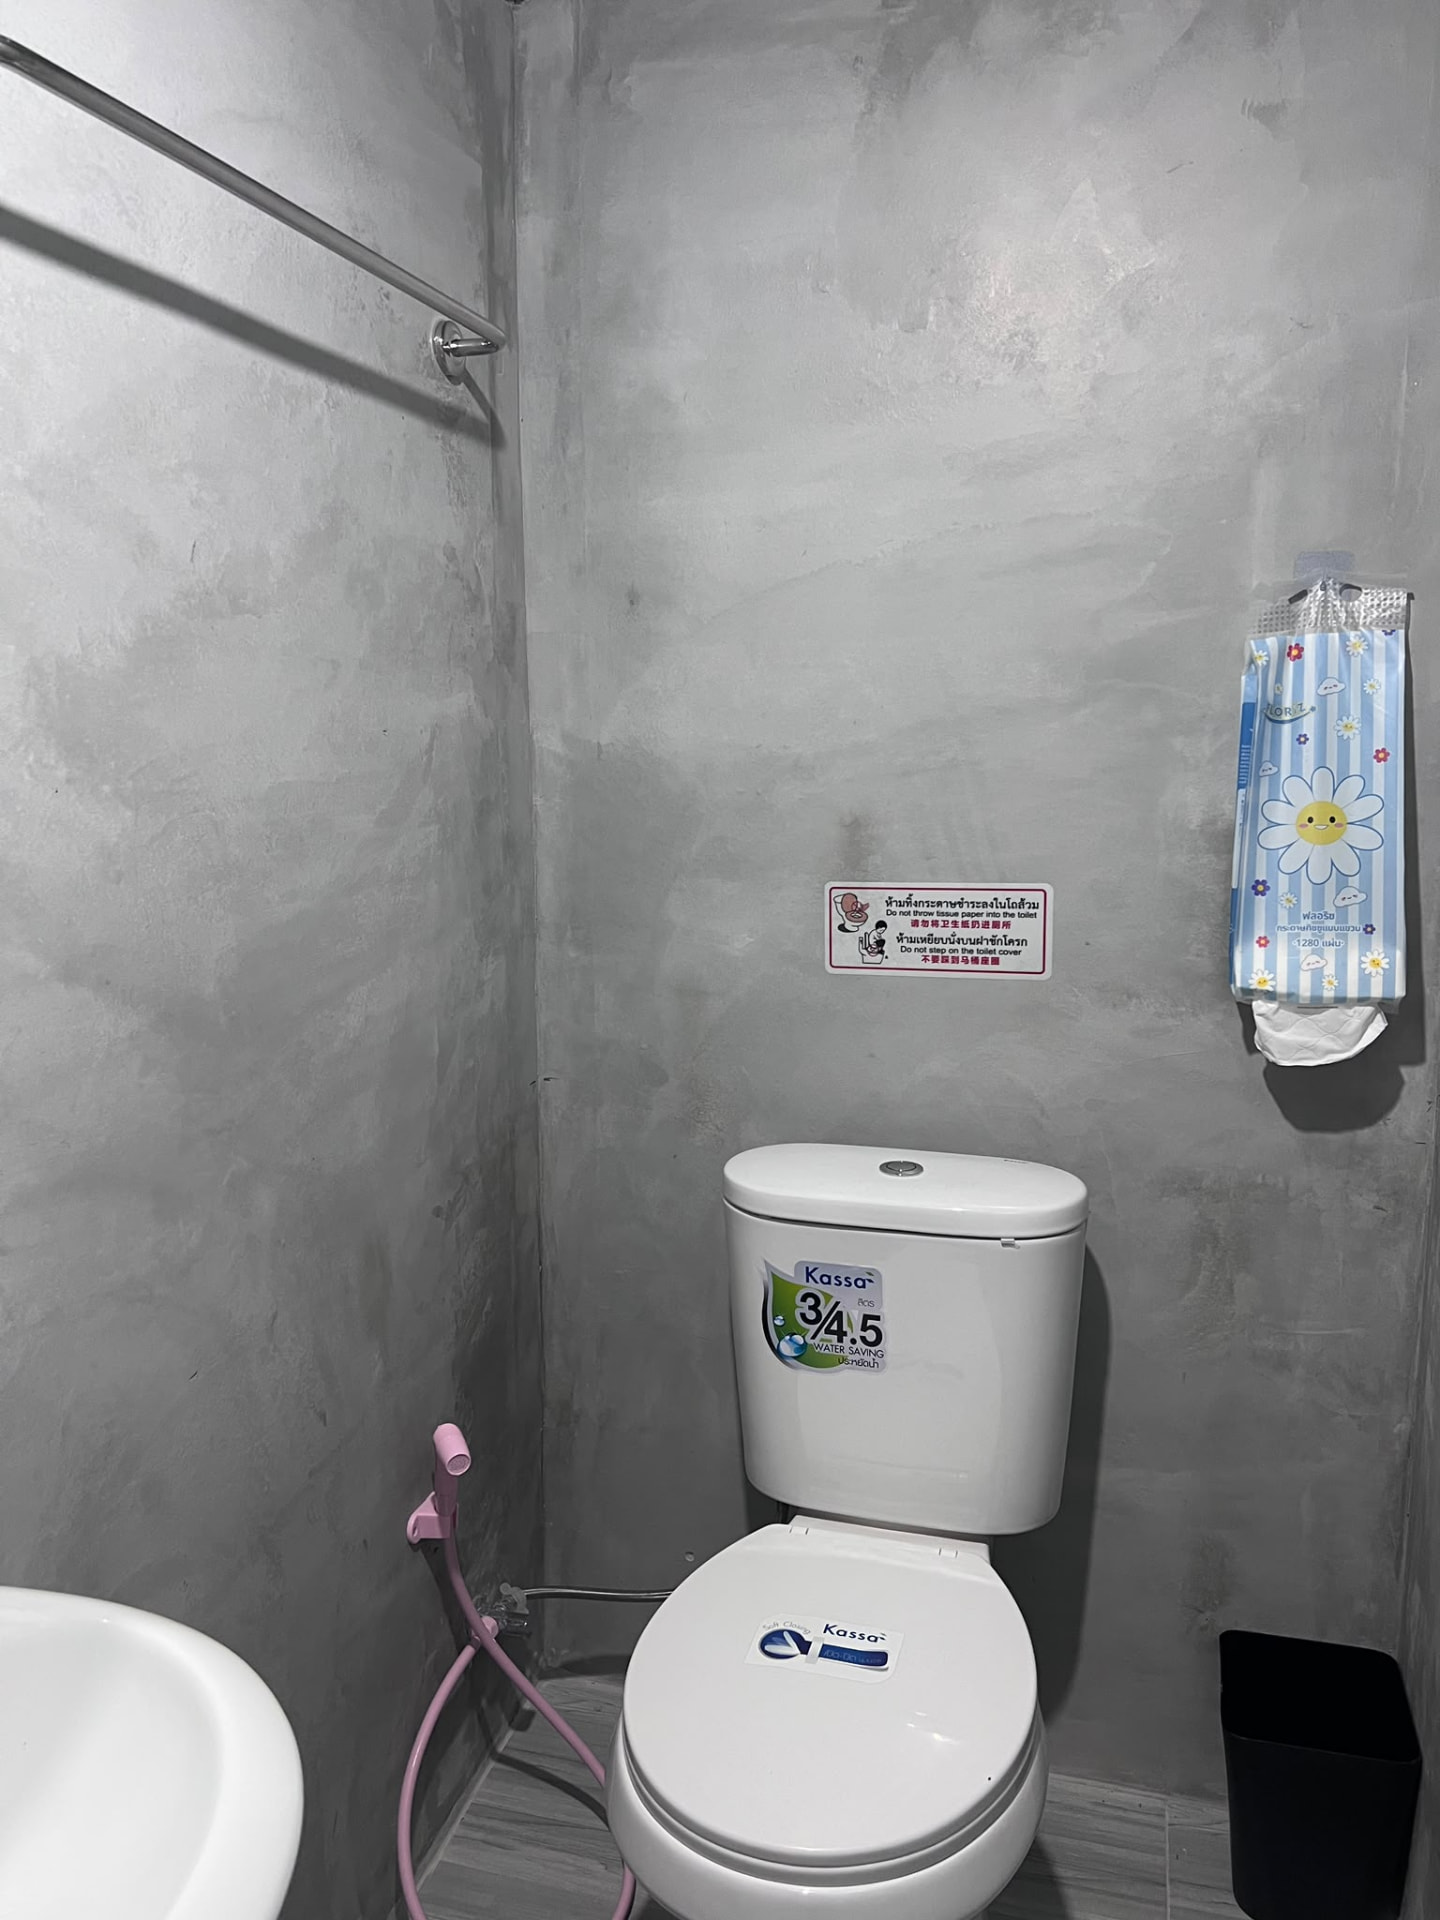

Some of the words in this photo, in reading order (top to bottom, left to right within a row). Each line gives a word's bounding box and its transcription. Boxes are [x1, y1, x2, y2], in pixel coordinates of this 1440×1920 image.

[885, 893, 1039, 910] ห้ามทิ้งกระดาษชำระลงในโถส้วม
[961, 911, 984, 919] paper
[896, 931, 1028, 946] ห้ามเหยียบนั่งบนฝาชักโครก
[1296, 939, 1320, 948] 1280
[900, 945, 912, 953] Do
[929, 947, 946, 955] step
[805, 1266, 867, 1289] Kassa
[814, 1342, 845, 1354] WATER
[848, 1346, 884, 1358] SAVING
[823, 1623, 879, 1643] Kassa
